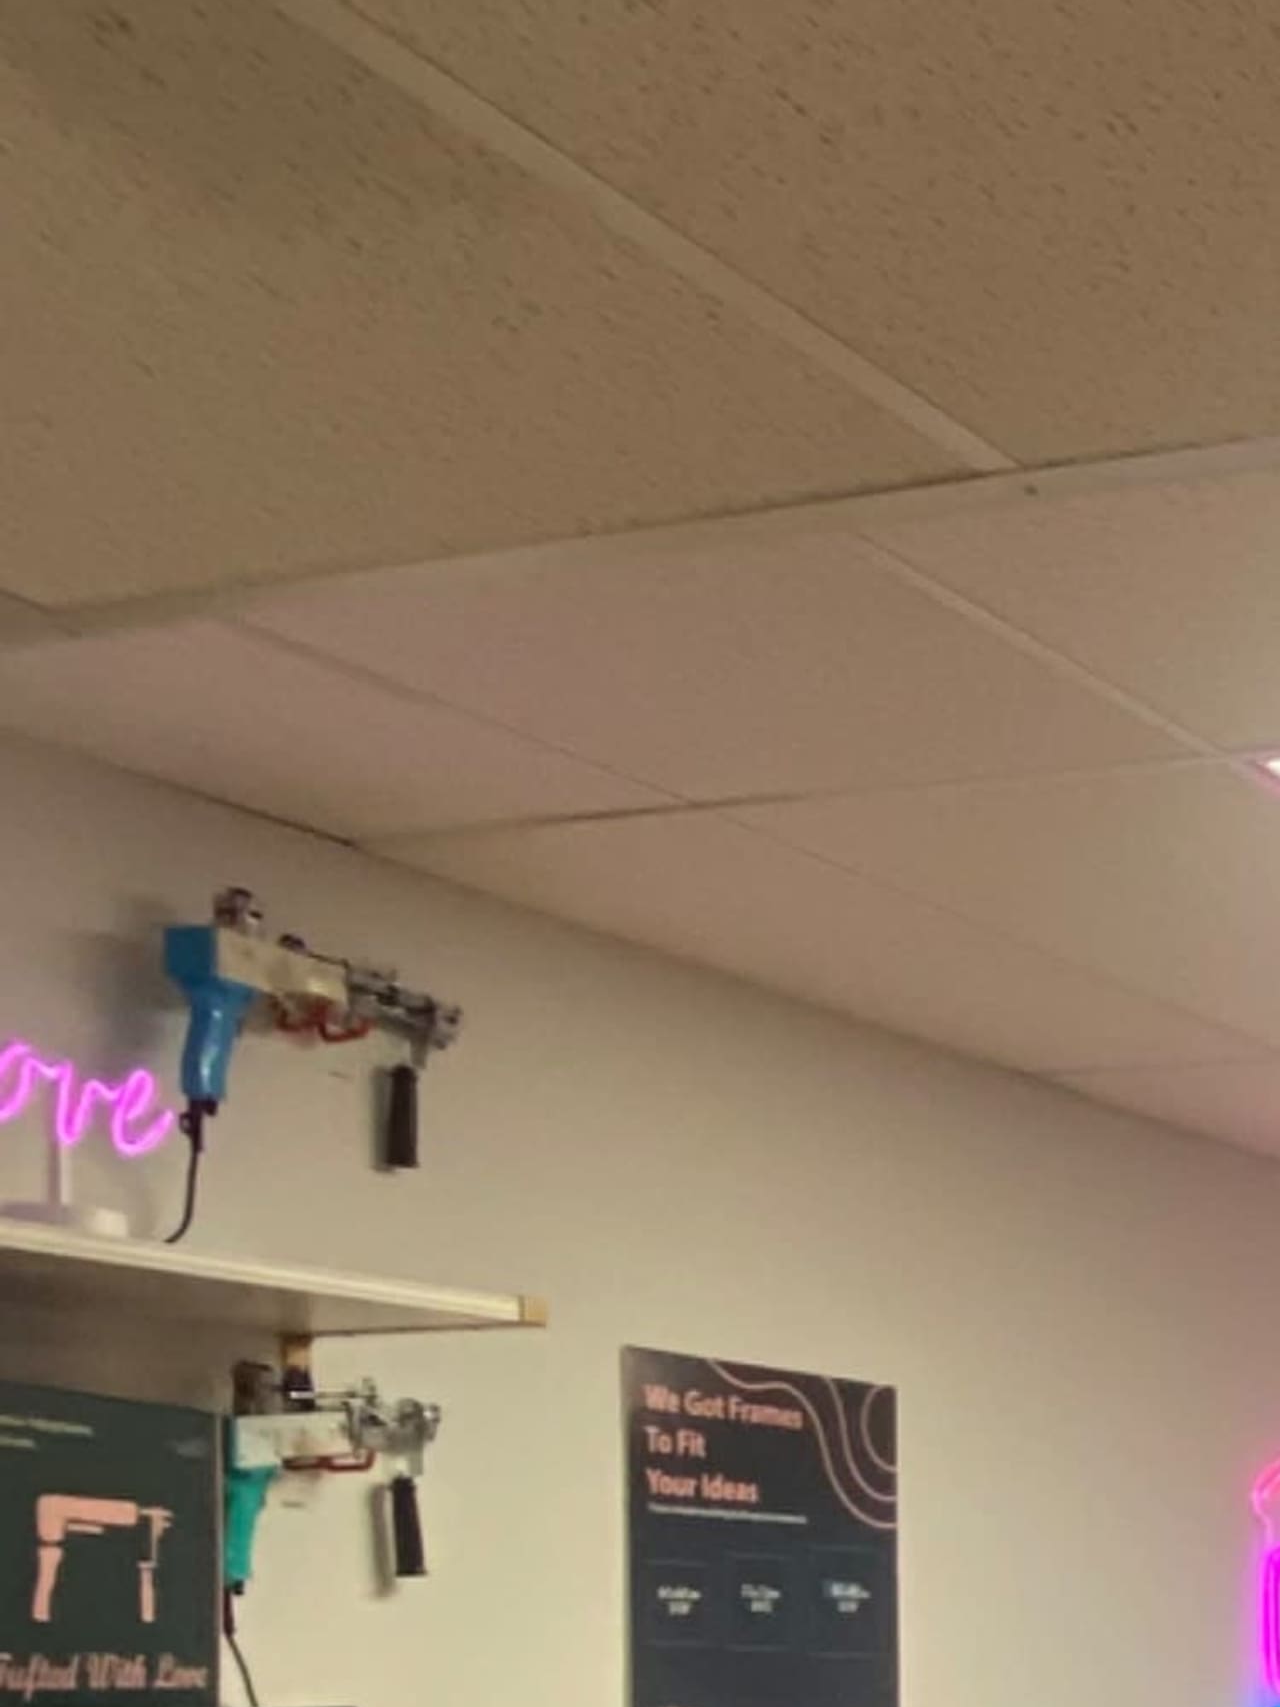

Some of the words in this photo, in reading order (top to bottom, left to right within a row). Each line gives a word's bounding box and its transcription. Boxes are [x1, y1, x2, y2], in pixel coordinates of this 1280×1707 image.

[643, 1383, 680, 1413] We
[683, 1389, 725, 1420] Got
[728, 1395, 804, 1430] Frames
[645, 1426, 673, 1454] To
[676, 1428, 706, 1458] Fit
[645, 1468, 698, 1497] Your
[701, 1472, 760, 1505] Ideas
[86, 1653, 149, 1690] With
